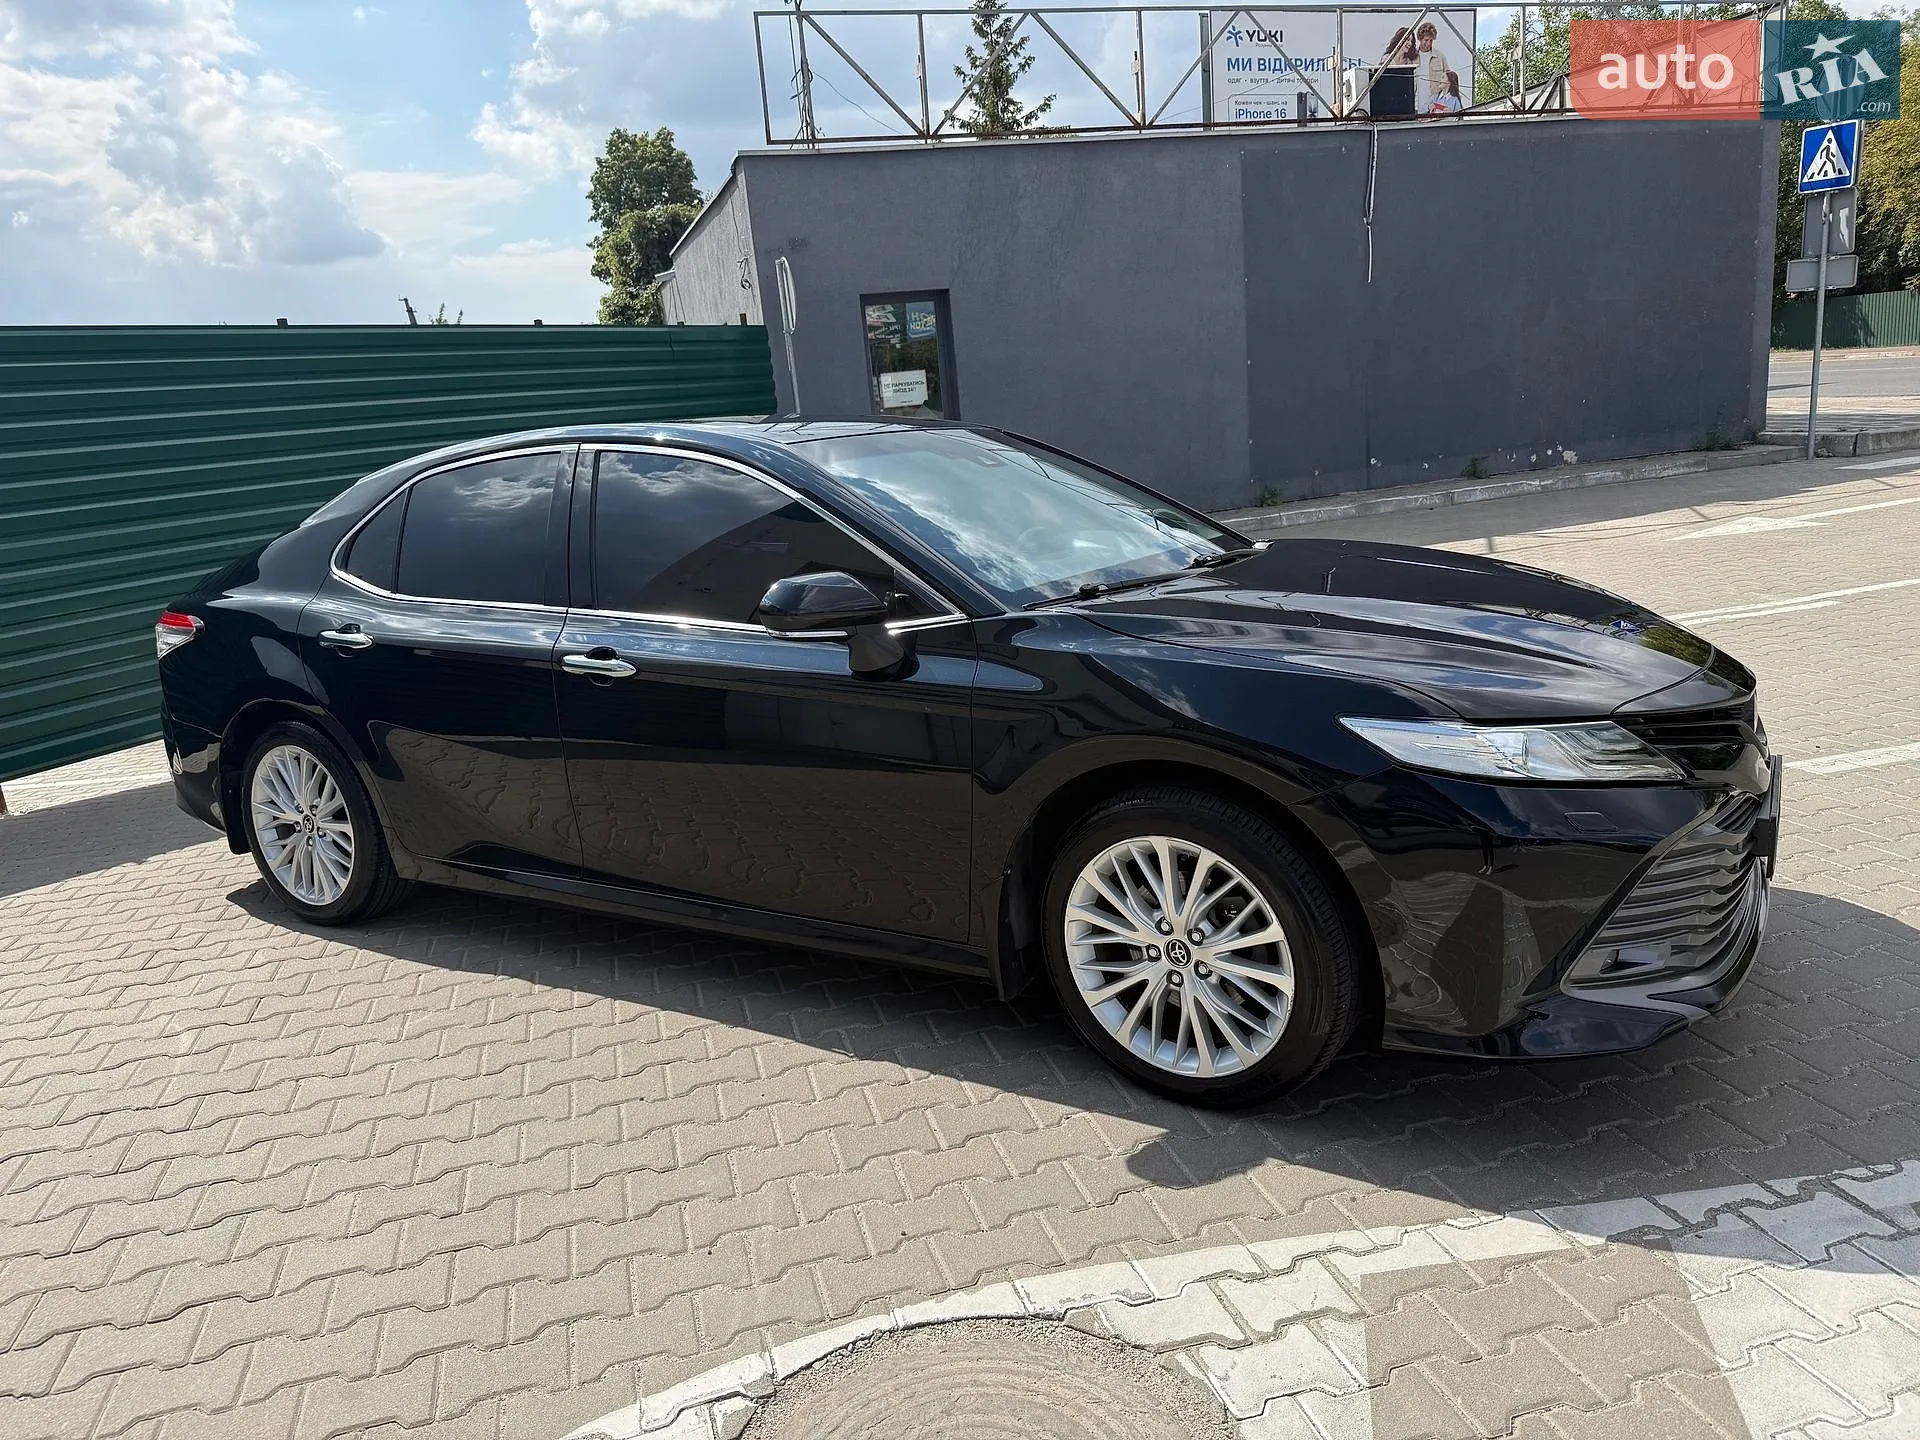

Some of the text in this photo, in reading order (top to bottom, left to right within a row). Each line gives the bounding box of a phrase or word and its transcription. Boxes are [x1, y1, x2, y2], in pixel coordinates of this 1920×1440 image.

[1246, 30, 1283, 42] YUKI
[1227, 57, 1362, 74] МИ ВІДКРИЛСЬ!
[1235, 108, 1287, 119] iPhone 16
